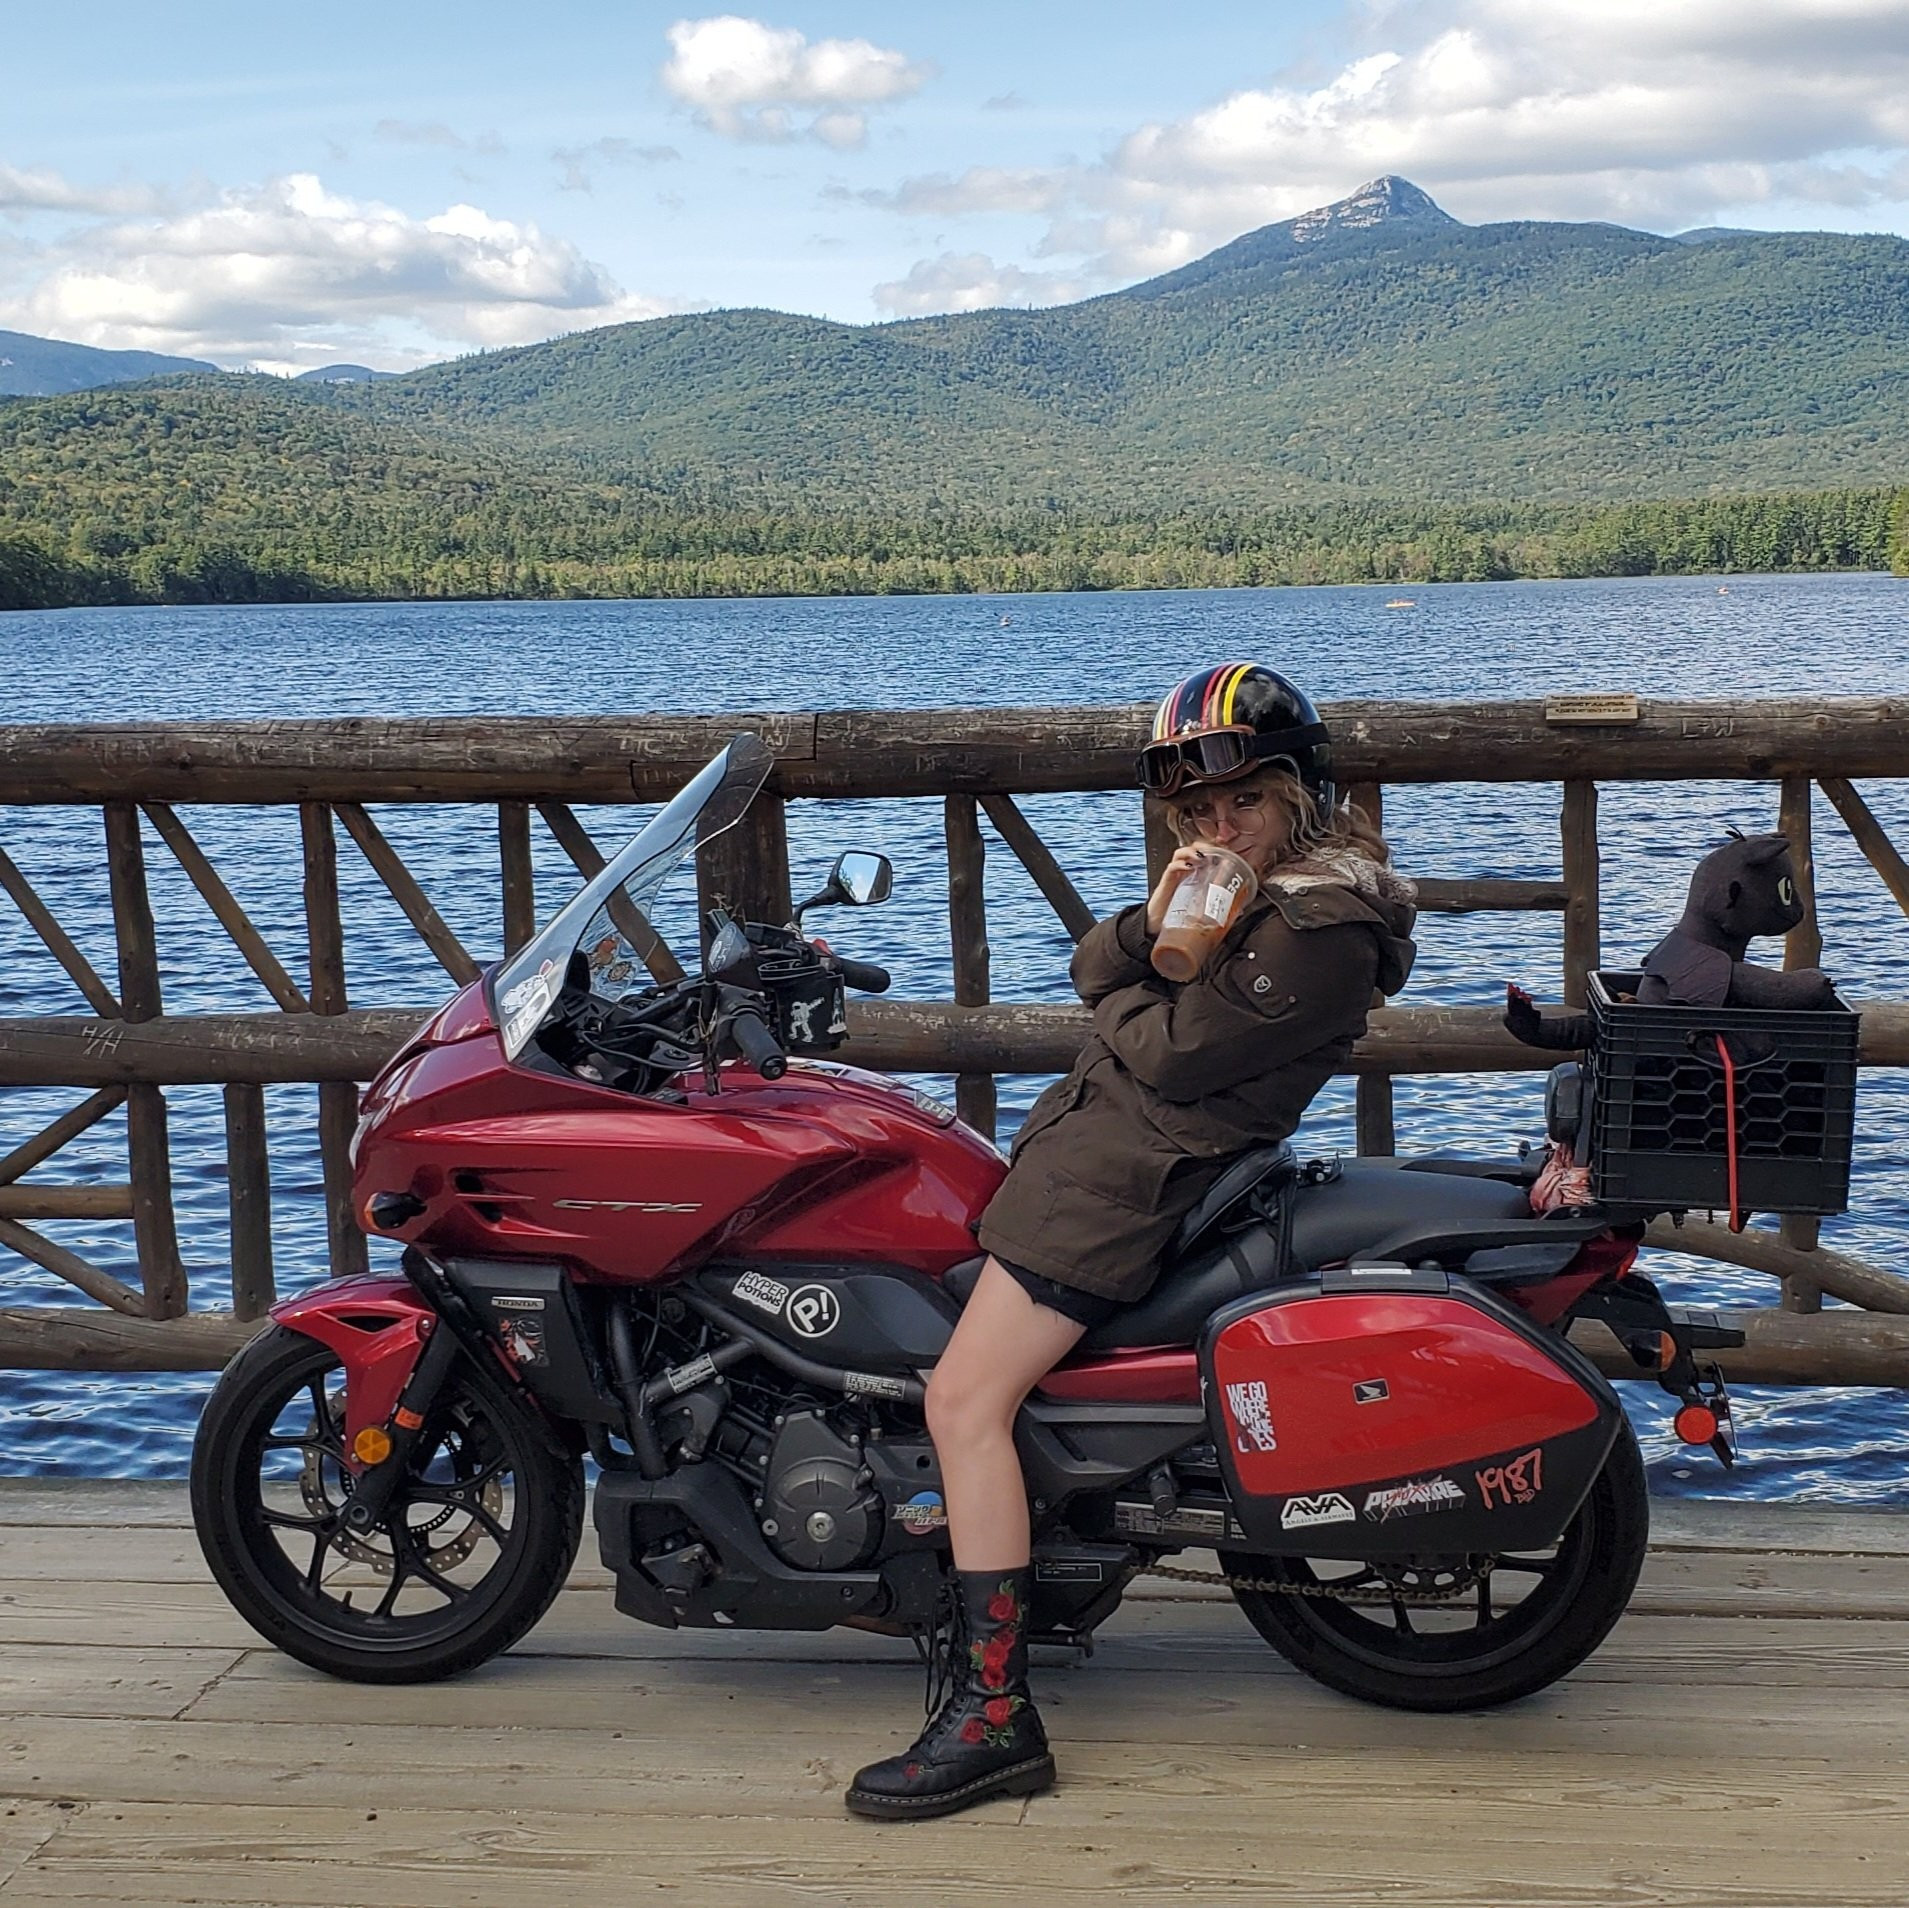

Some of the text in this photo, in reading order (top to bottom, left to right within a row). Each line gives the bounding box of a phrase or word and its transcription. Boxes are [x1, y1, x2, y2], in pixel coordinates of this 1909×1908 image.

[552, 1199, 703, 1213] CTX
[736, 1281, 782, 1307] POTIONS
[742, 1272, 788, 1299] HYPER
[497, 1299, 539, 1307] HONDA
[1225, 1383, 1249, 1402] WE
[1248, 1381, 1268, 1400] GO
[1475, 1447, 1542, 1510] 1987
